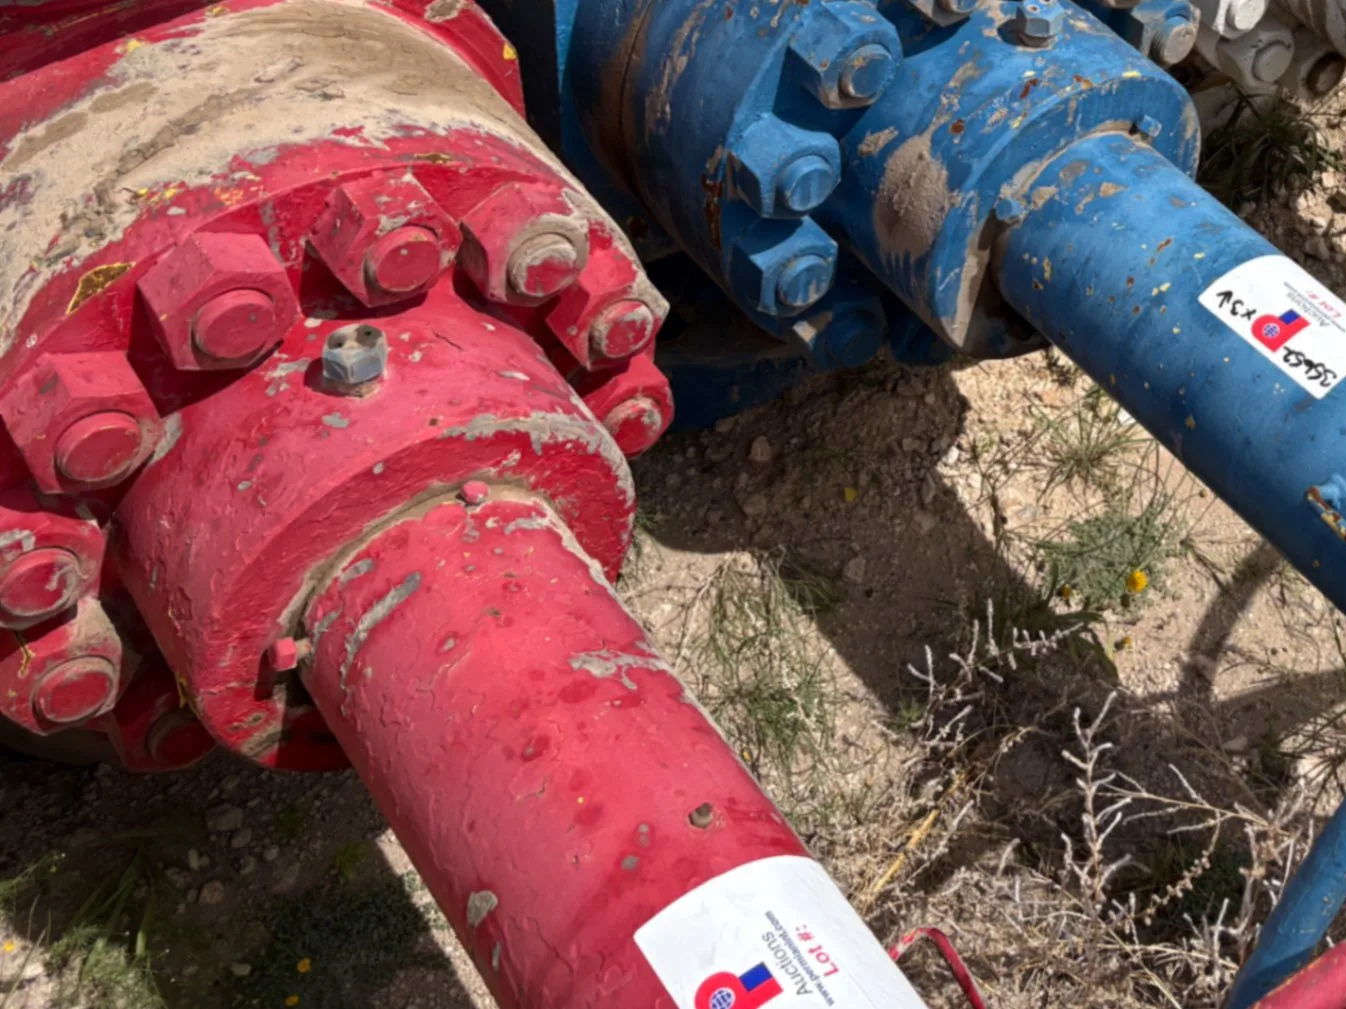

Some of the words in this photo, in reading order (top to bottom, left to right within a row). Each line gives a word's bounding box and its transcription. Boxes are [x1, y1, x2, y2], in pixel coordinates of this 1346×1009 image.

[761, 930, 813, 996] Auctions
[764, 909, 835, 1007] www.permianint.com
[807, 944, 839, 978] Lot
